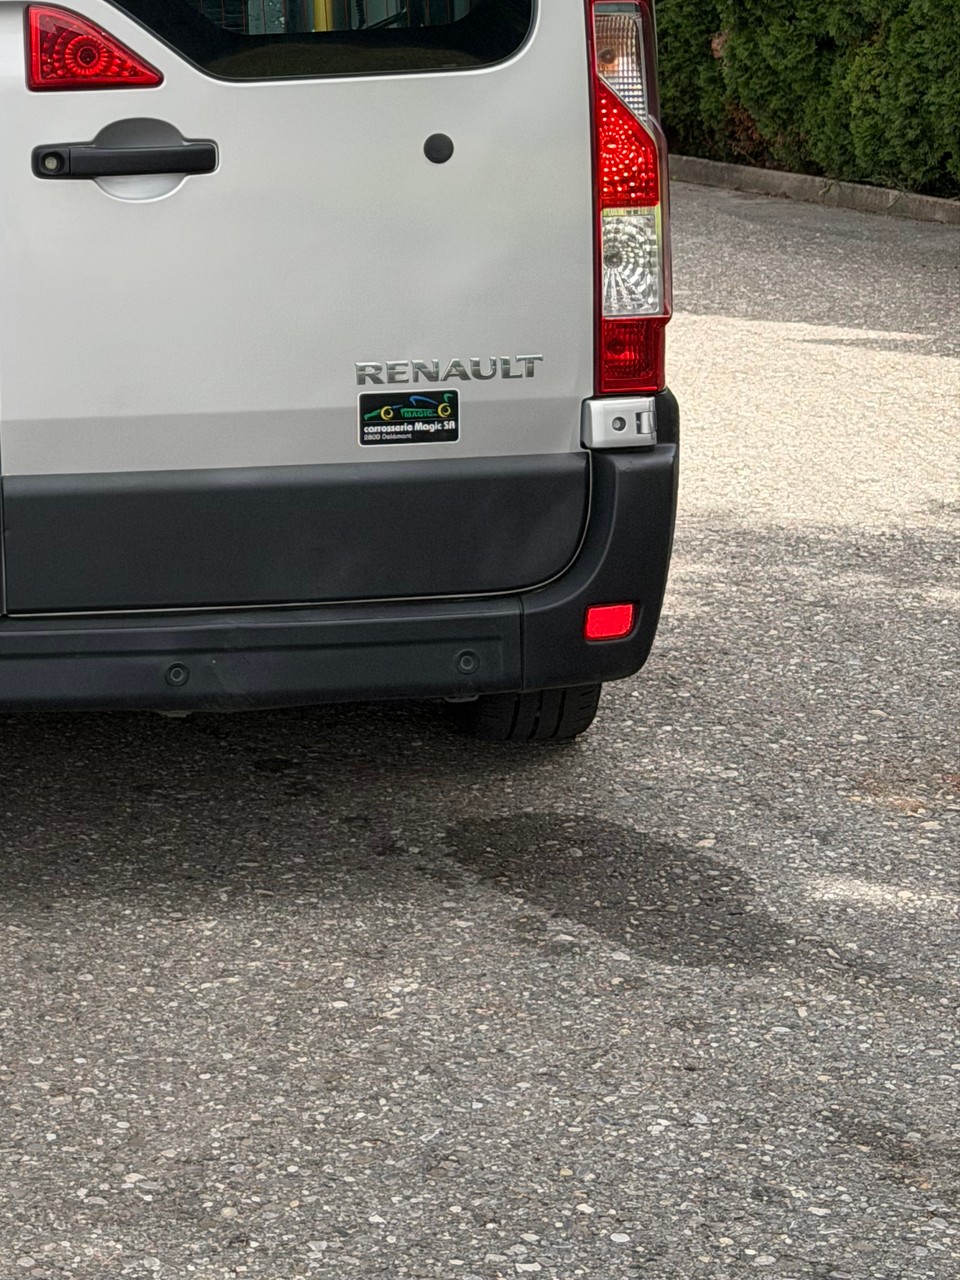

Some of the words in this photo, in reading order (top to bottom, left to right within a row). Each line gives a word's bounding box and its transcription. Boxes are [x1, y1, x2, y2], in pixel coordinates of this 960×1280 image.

[355, 354, 544, 385] RENAULT
[363, 423, 413, 433] carrosserie
[414, 422, 442, 433] Magic
